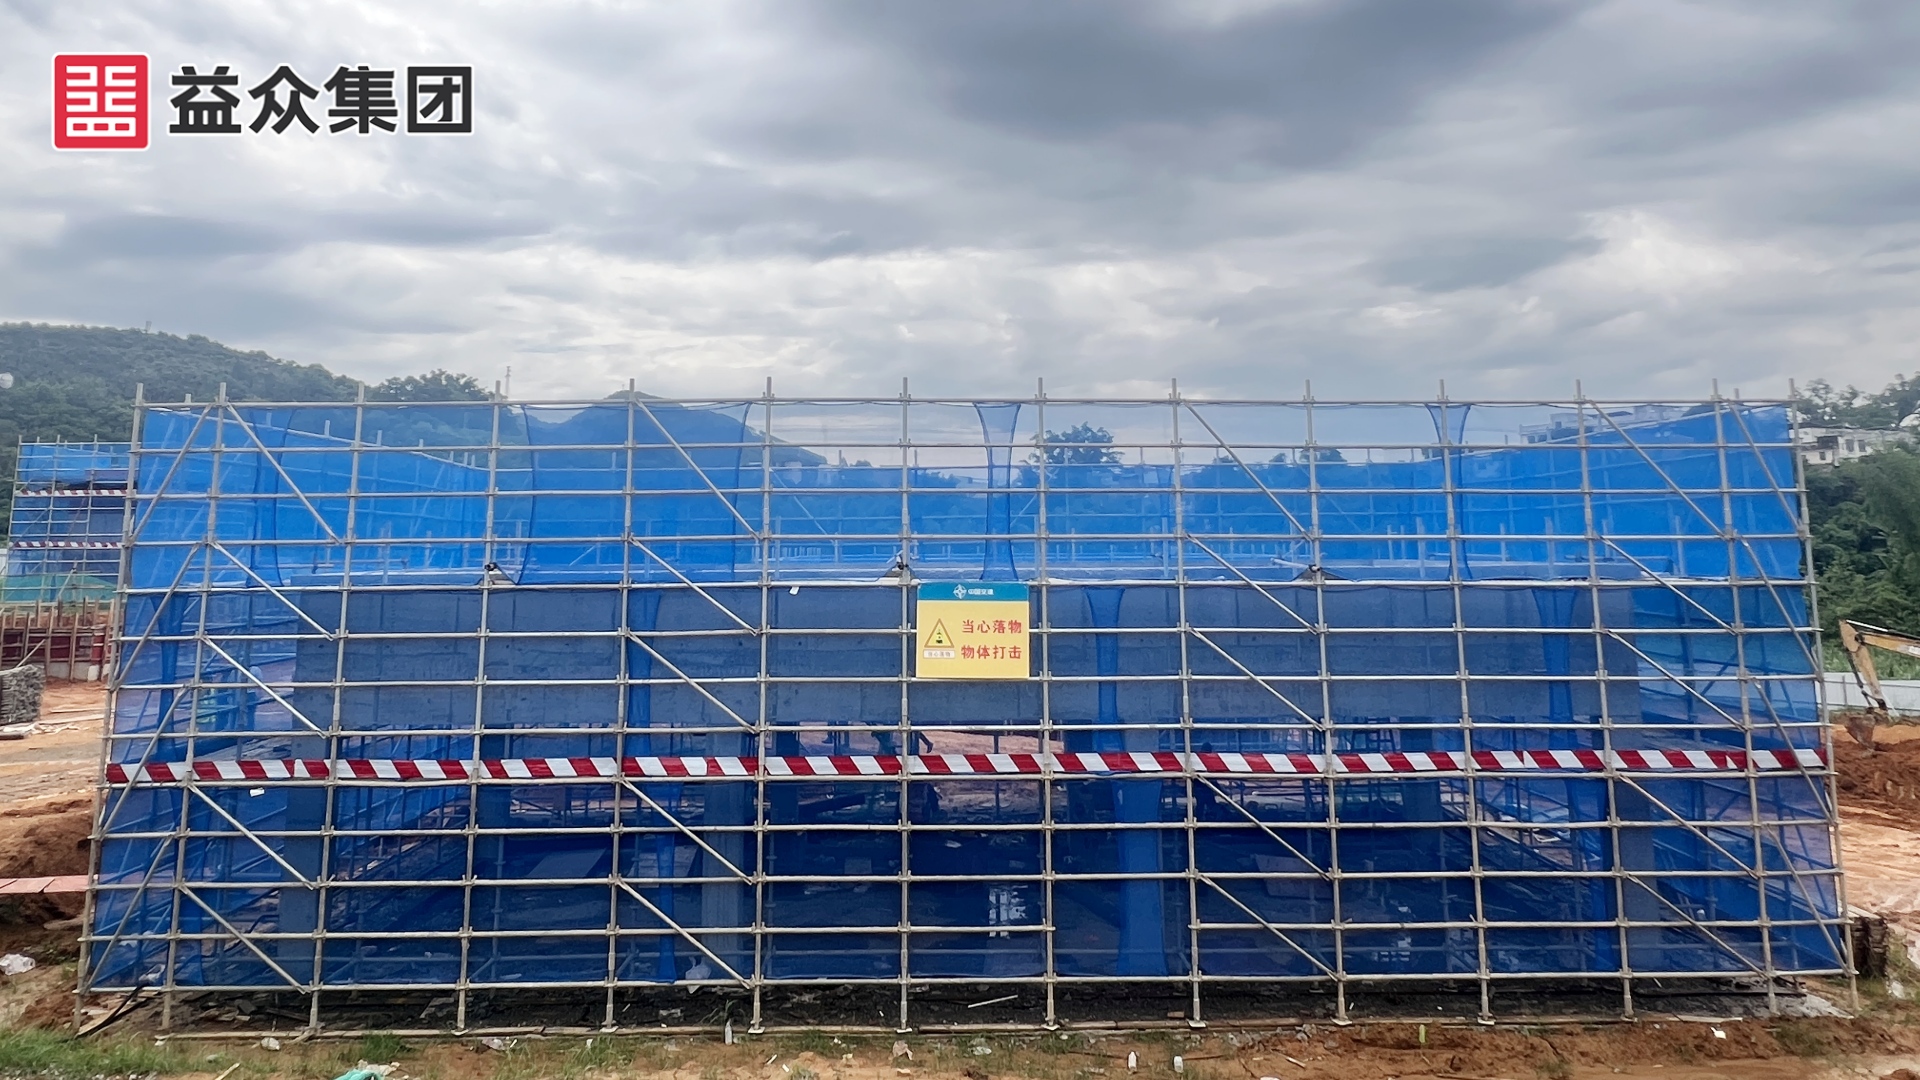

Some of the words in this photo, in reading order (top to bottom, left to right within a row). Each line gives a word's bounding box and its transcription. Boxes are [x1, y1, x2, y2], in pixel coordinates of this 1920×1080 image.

[962, 619, 1022, 634] 当心落物
[961, 645, 1022, 659] 物体打击
